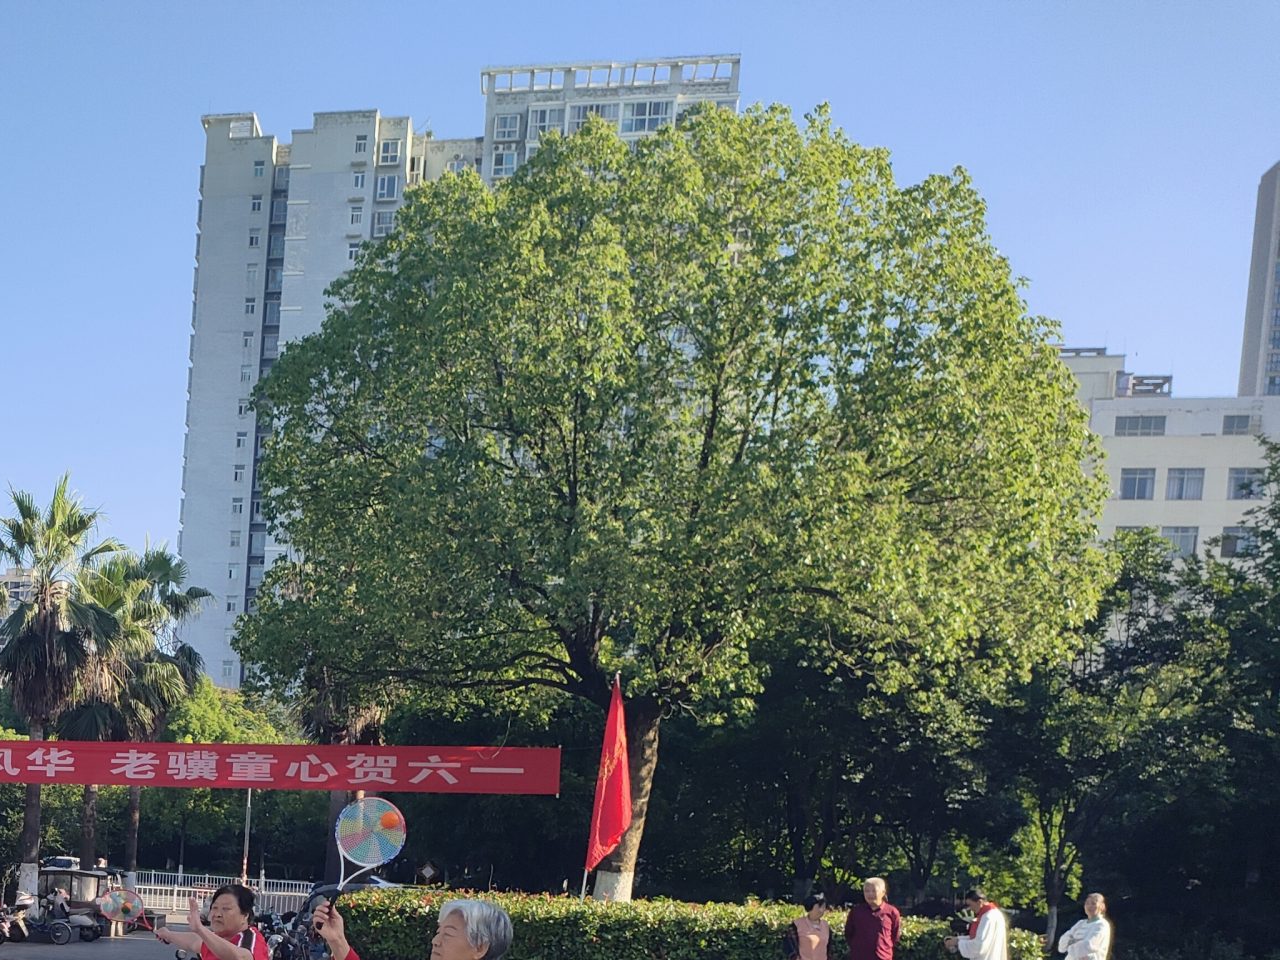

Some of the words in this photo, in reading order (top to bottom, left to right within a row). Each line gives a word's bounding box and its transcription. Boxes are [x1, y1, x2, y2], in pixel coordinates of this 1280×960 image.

[110, 748, 524, 785] 老骥童心贺六一
